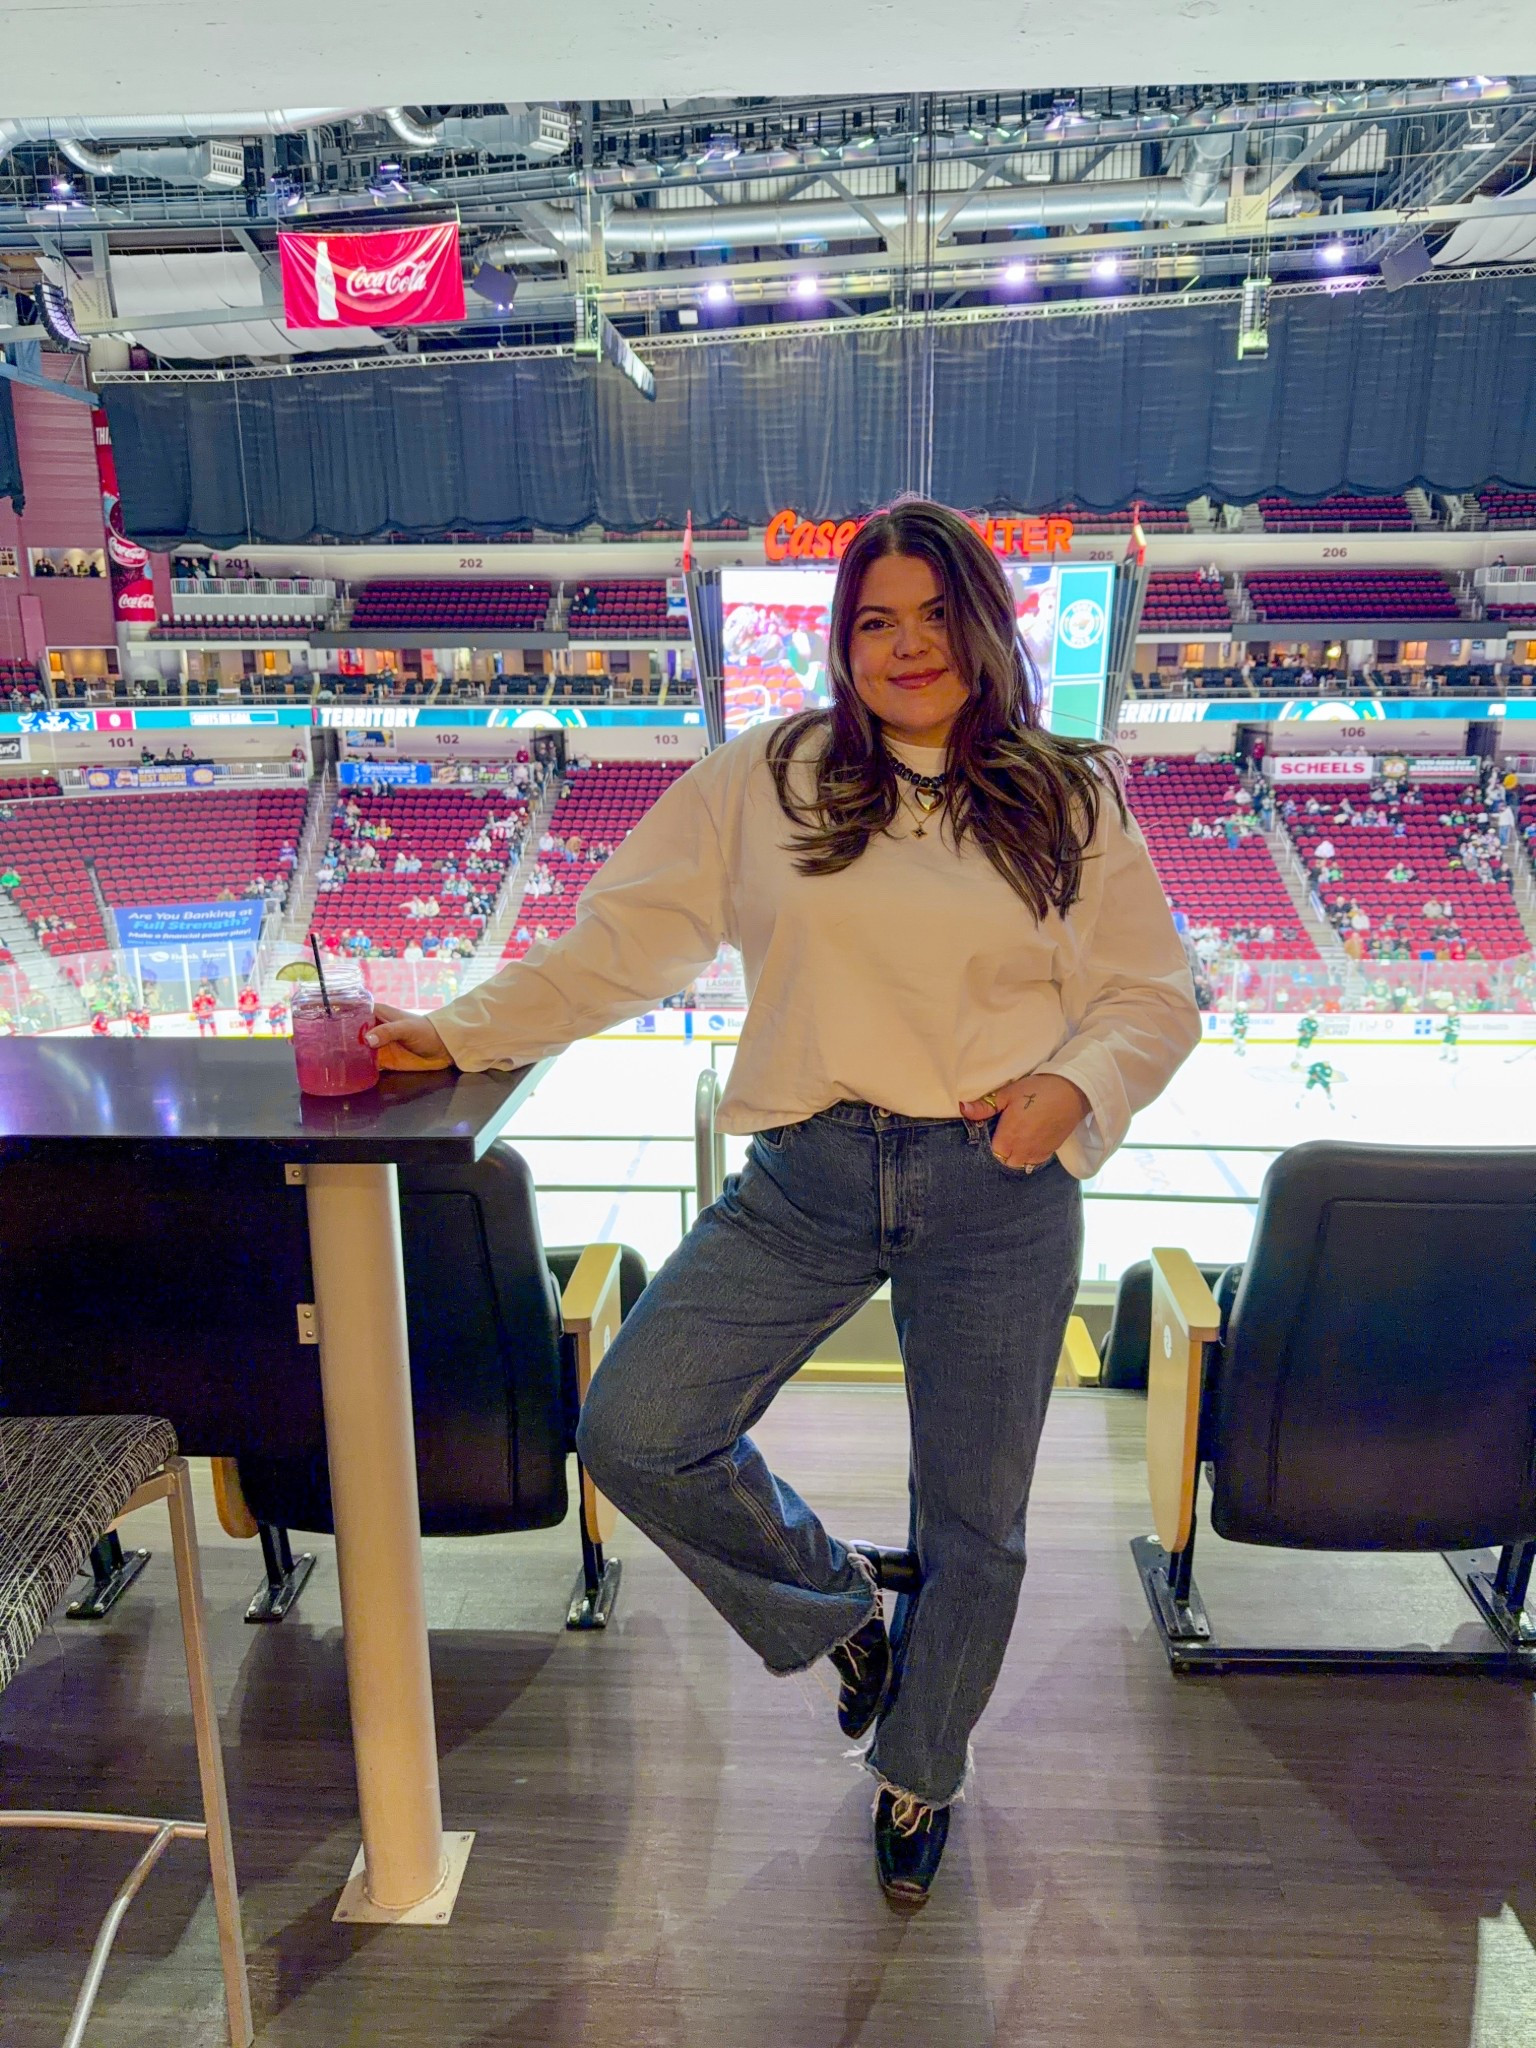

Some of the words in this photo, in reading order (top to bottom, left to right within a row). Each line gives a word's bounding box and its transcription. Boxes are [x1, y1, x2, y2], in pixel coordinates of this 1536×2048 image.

[967, 518, 1074, 553] NTER
[1089, 551, 1114, 561] 205
[1322, 547, 1347, 557] 206
[225, 558, 250, 569] 201
[459, 558, 483, 568] 202
[321, 707, 420, 727] TERRITORY
[1117, 702, 1210, 723] ERRITORY
[1340, 727, 1365, 737] 106
[108, 737, 134, 748] 101
[435, 734, 460, 744] 102
[654, 735, 679, 745] 103
[1280, 761, 1365, 774] SCHEELS
[128, 912, 152, 921] Are
[156, 911, 180, 921] You
[183, 910, 236, 921] Banking
[238, 908, 253, 916] at
[133, 920, 164, 930] Full
[168, 916, 249, 931] Strength?
